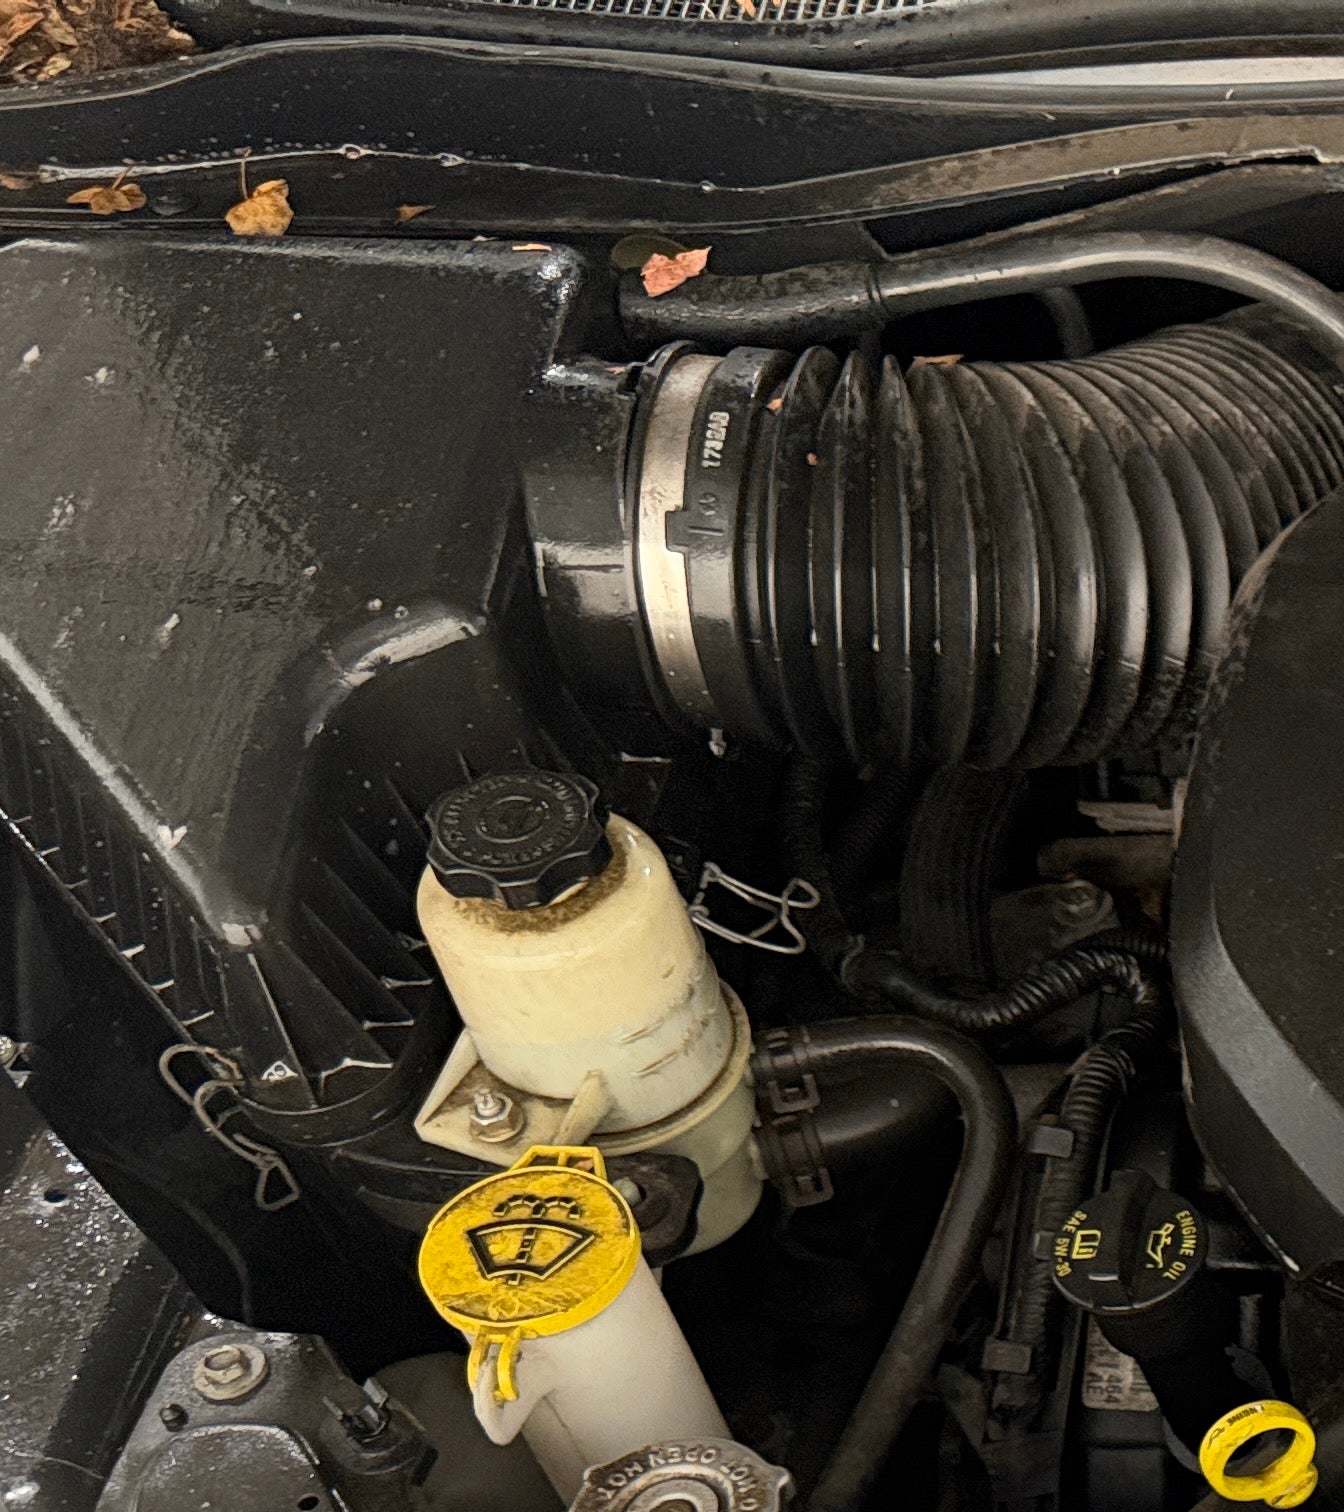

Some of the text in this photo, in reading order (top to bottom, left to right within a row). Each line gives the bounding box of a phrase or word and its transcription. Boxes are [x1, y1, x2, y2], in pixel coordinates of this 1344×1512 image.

[1054, 1210, 1088, 1278] SAE 5W-30
[1162, 1209, 1198, 1281] ENGINE OIL
